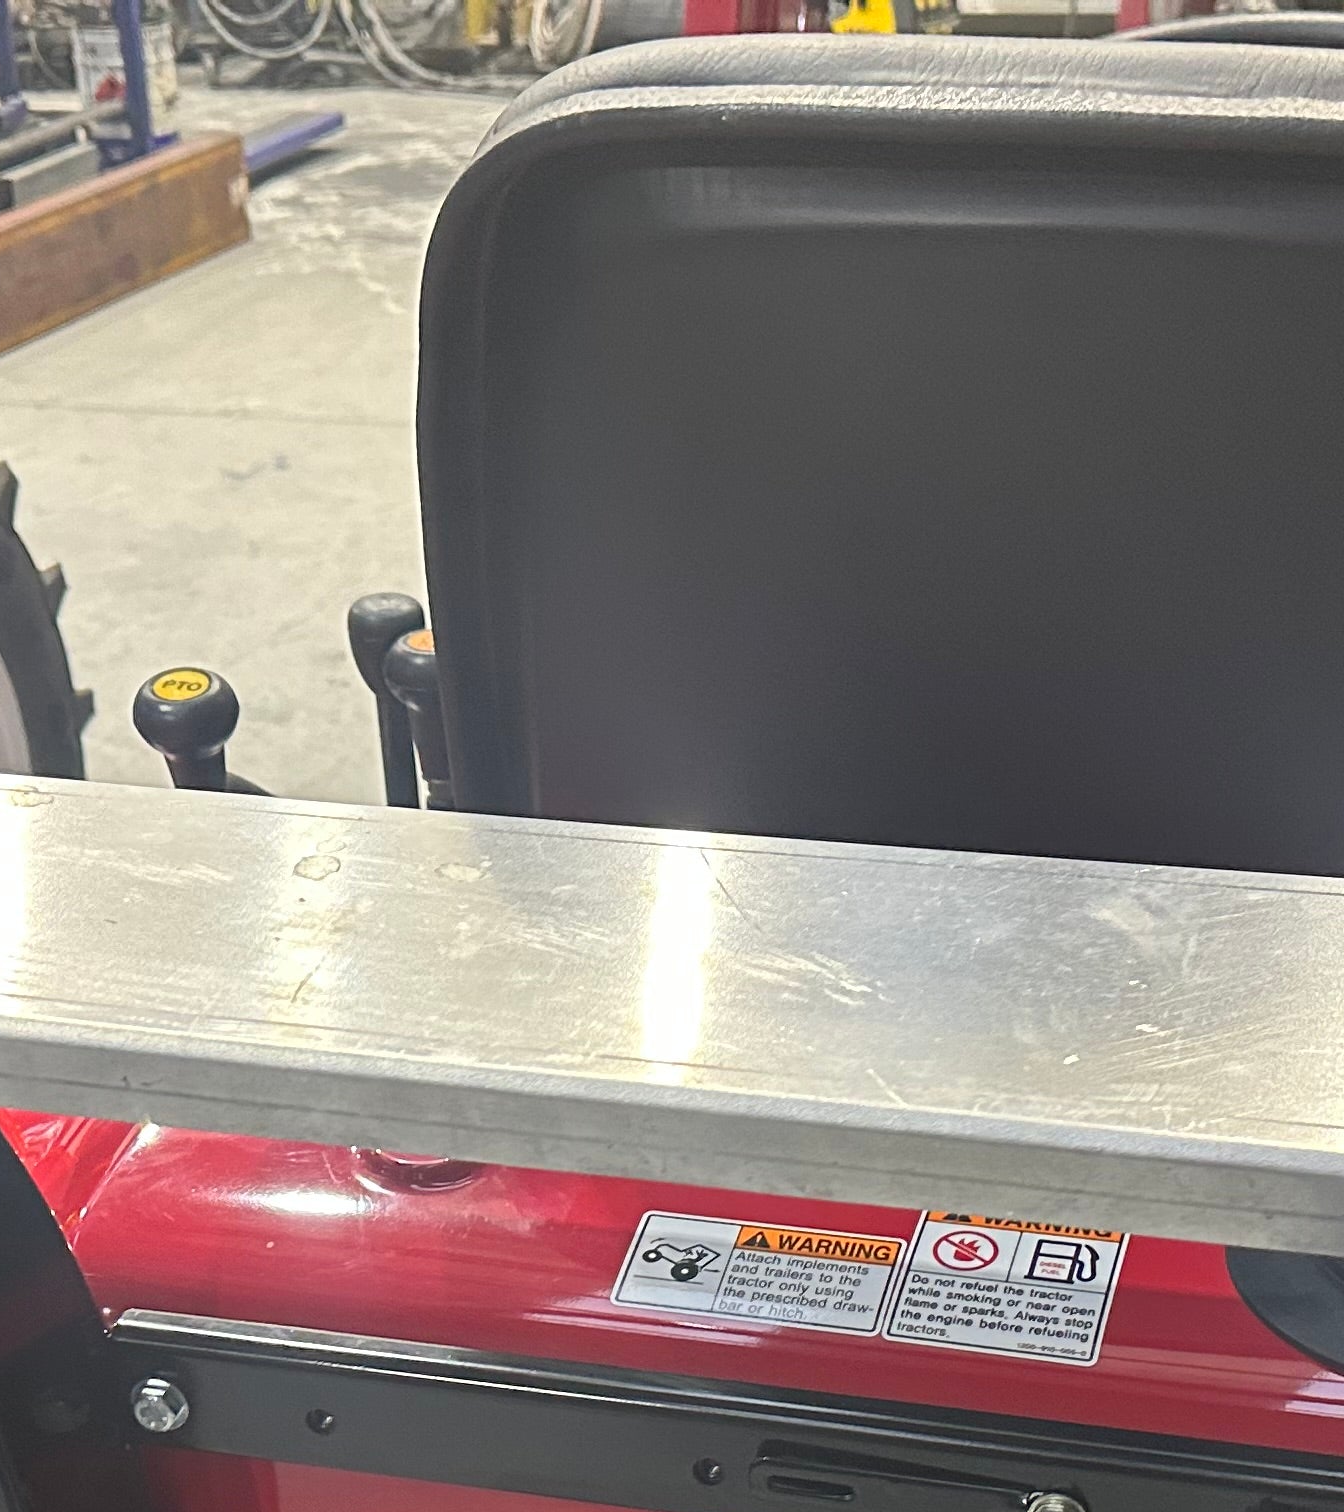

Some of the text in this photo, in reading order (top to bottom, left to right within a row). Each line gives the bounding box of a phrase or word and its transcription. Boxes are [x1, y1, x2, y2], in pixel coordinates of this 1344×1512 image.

[161, 679, 202, 692] PTO
[778, 1234, 892, 1261] WARNING
[731, 1264, 862, 1287] and trailers to the
[735, 1251, 869, 1275] Attach implements
[724, 1286, 874, 1314] the prescribed draw-
[728, 1275, 854, 1301] tractor only using
[912, 1274, 1073, 1302] Do not refuel the tractor
[719, 1300, 741, 1312] bar
[748, 1304, 763, 1314] or
[904, 1297, 1093, 1330] flame or sparks. Always stop
[909, 1286, 1096, 1317] while smoking or near open
[897, 1321, 950, 1338] tractors.
[900, 1309, 1089, 1343] the engine before refueling
